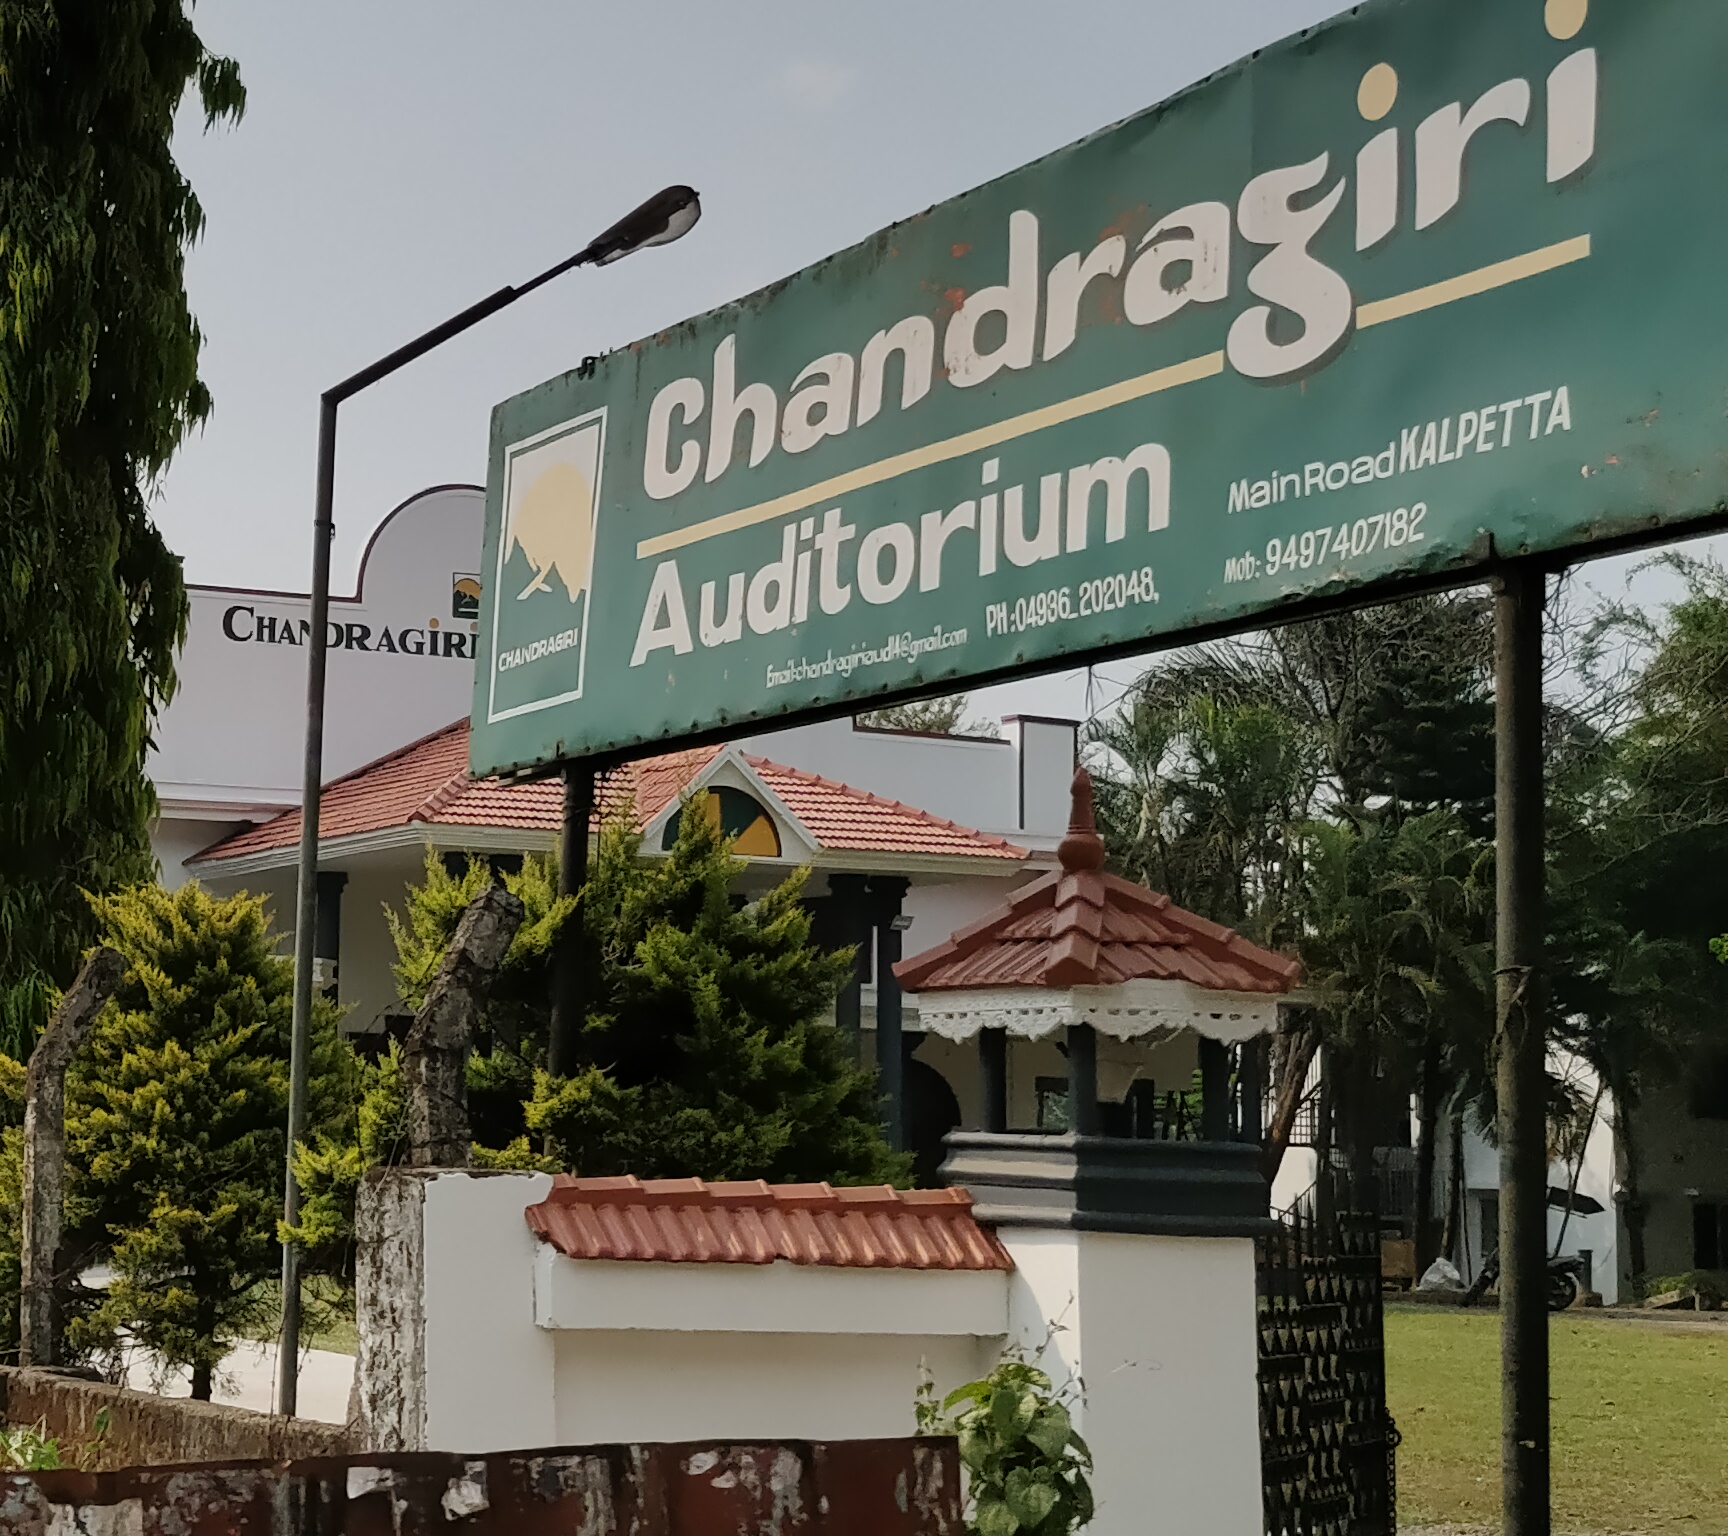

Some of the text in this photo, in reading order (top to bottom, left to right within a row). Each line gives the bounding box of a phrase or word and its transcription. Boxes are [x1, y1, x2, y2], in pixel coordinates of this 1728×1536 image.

[1227, 385, 1572, 514] Main Road KALPETTA
[629, 442, 1172, 668] Auditorium
[1224, 502, 1428, 584] Mob: 9497407182
[498, 627, 579, 672] CHANDRAGIRI
